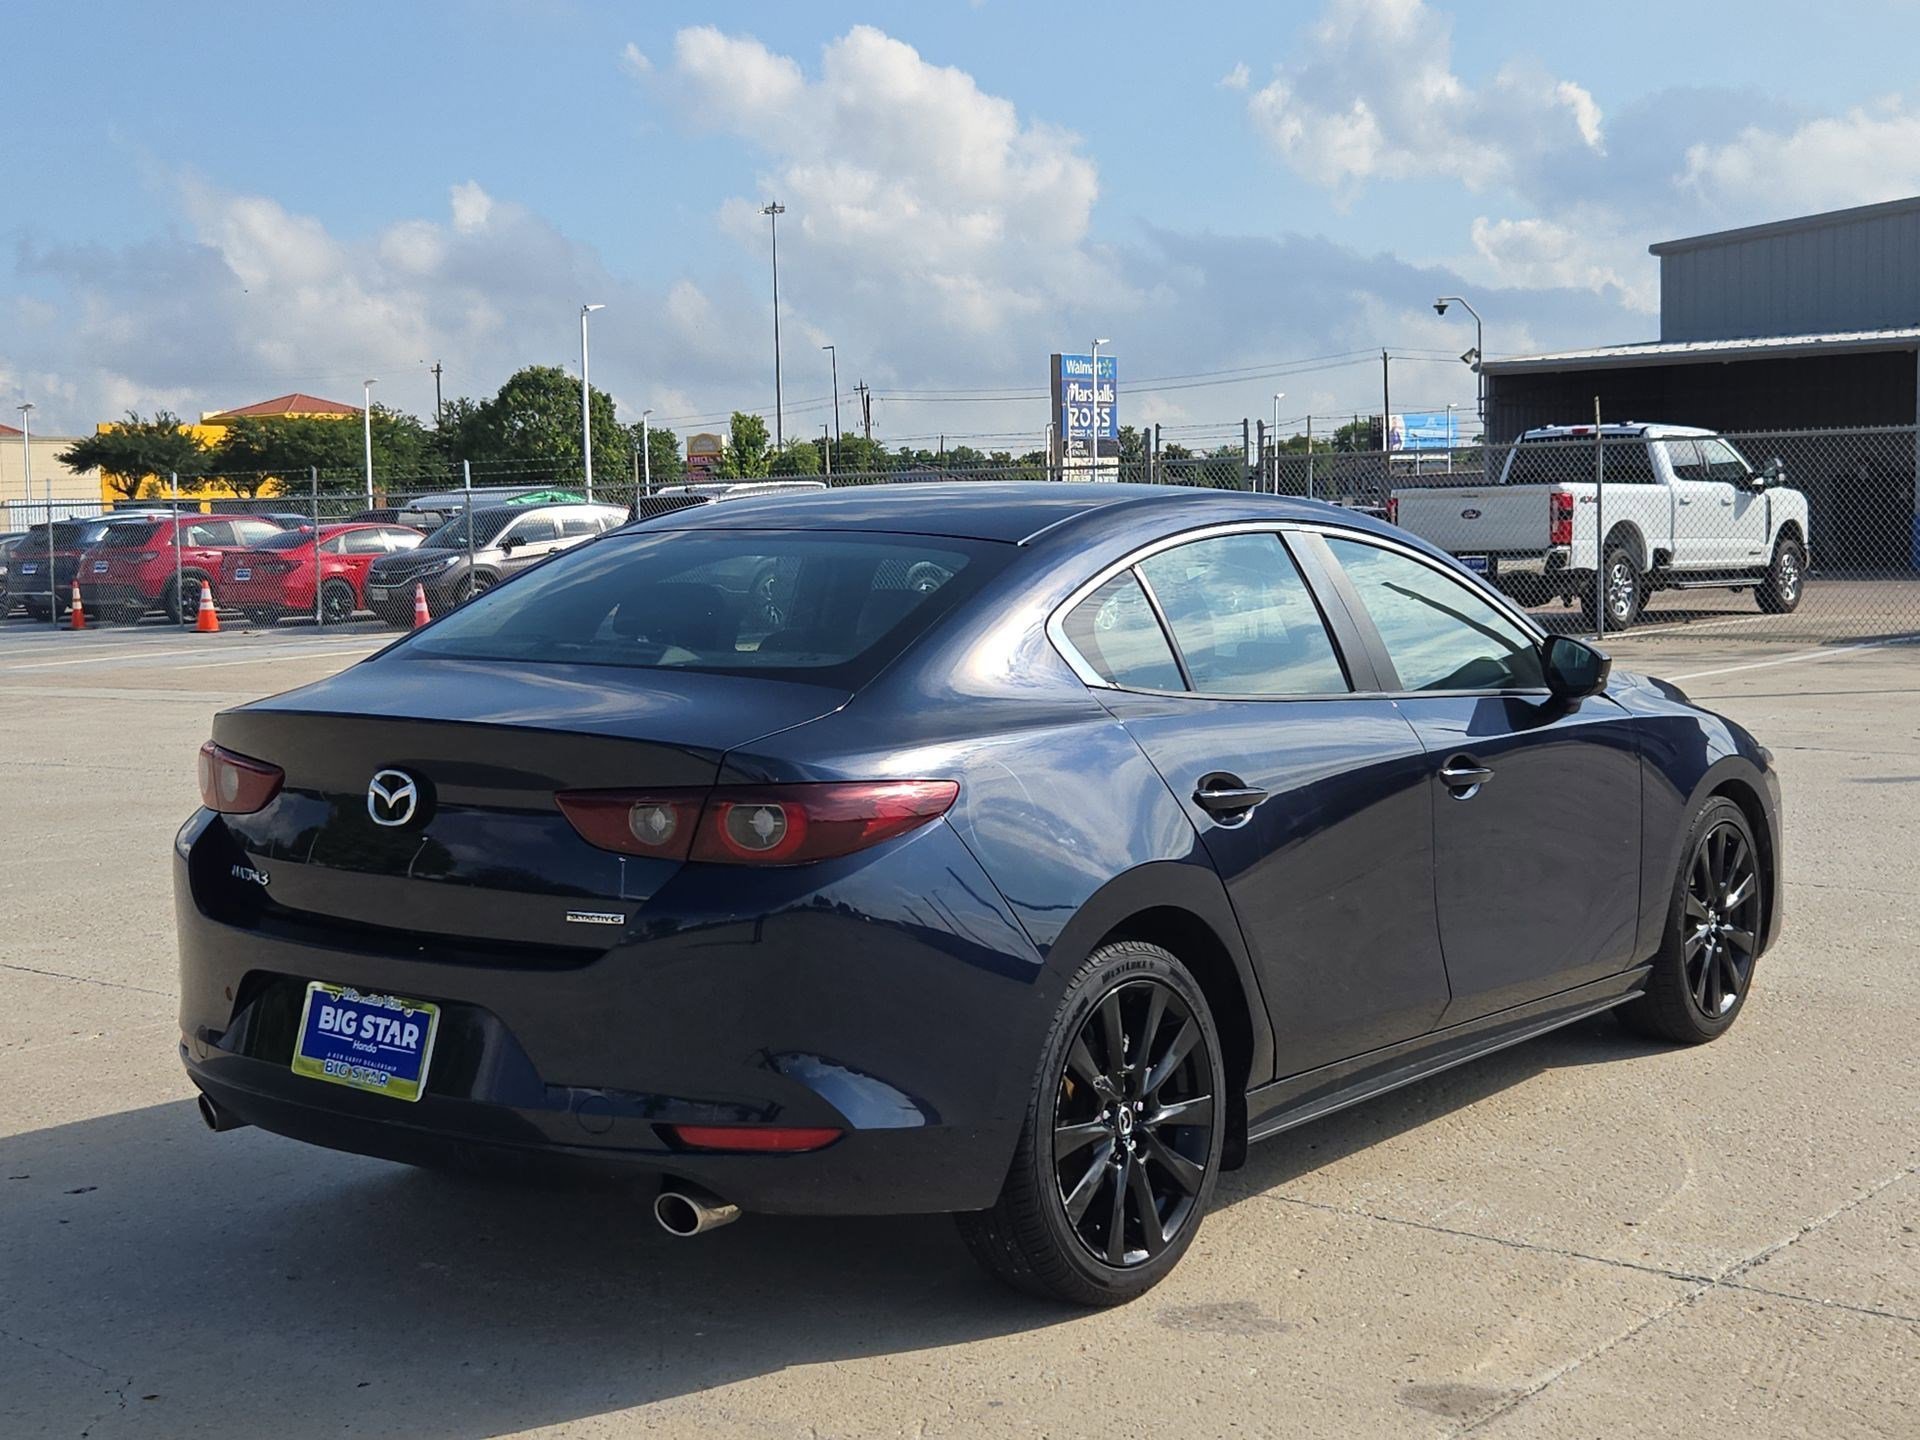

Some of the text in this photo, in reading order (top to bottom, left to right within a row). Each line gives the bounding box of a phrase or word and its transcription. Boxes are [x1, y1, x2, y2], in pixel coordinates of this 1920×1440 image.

[1066, 359, 1102, 375] Walmat
[318, 1005, 419, 1049] BIG STAR
[352, 1040, 378, 1054] Honda
[325, 1060, 389, 1087] BIG STAR
